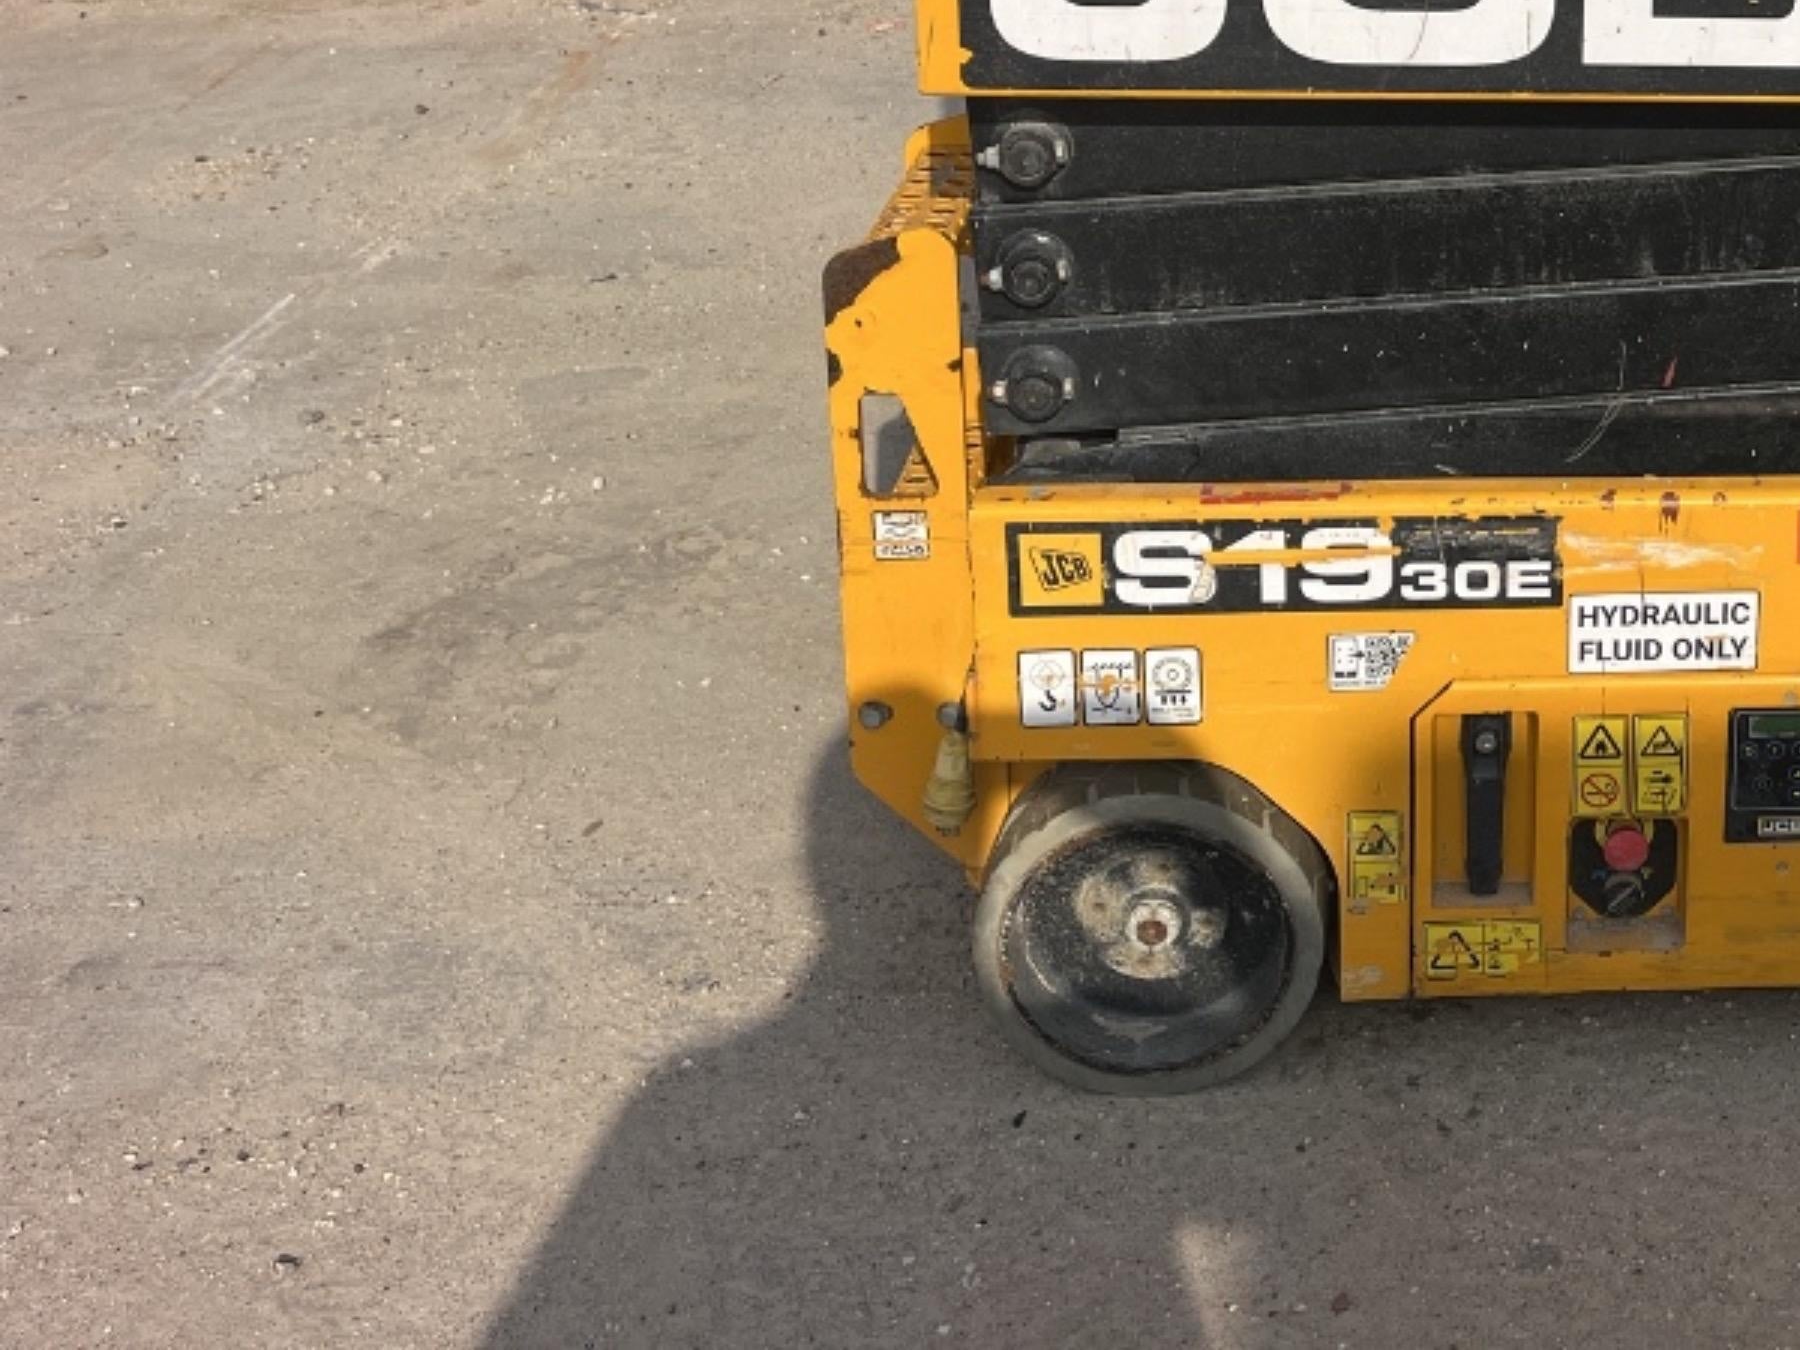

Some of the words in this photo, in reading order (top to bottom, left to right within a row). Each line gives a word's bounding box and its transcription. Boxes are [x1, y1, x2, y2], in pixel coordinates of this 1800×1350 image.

[1039, 548, 1091, 588] JCB
[1577, 602, 1751, 628] HYDRAULIC
[1578, 638, 1663, 663] FLUID
[1672, 636, 1749, 661] ONLY
